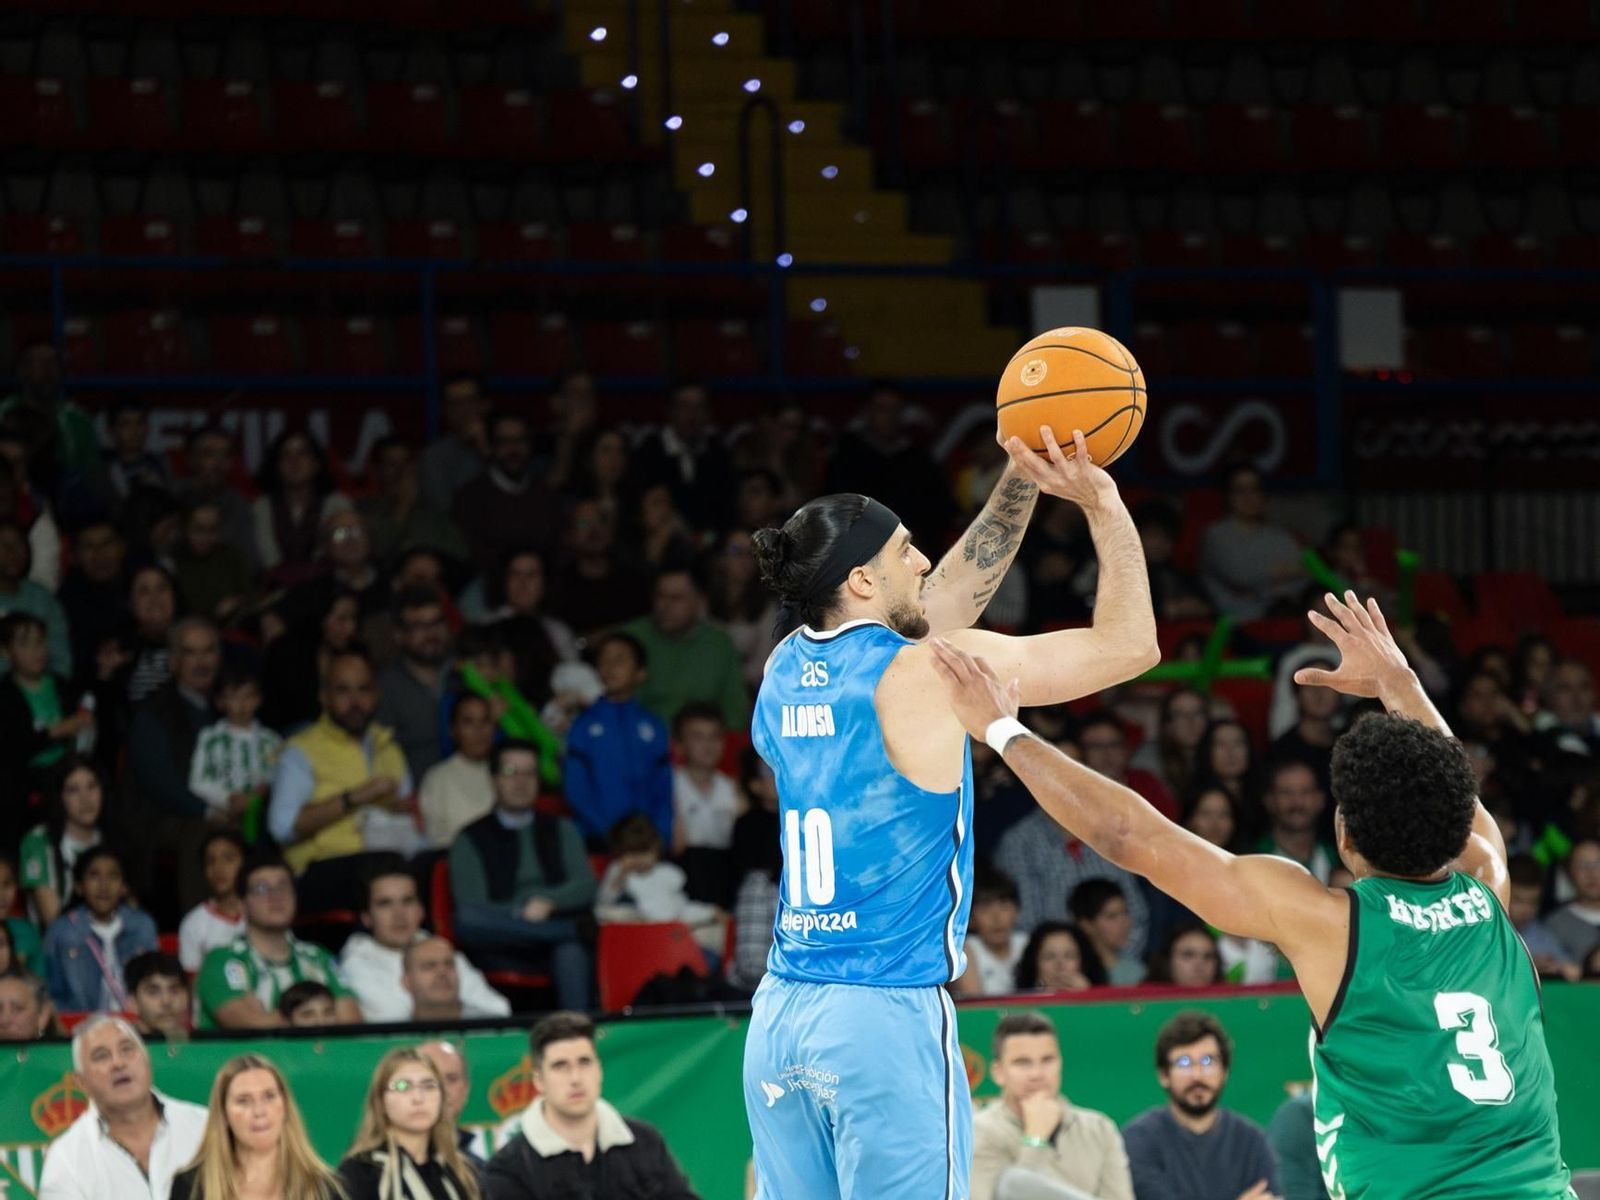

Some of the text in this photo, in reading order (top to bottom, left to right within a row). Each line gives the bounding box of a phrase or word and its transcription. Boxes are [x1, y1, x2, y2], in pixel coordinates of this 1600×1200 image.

[801, 660, 829, 687] as
[781, 704, 836, 738] ALONSO
[785, 807, 836, 908] 10
[779, 909, 858, 940] elepizza
[1433, 991, 1516, 1106] 3
